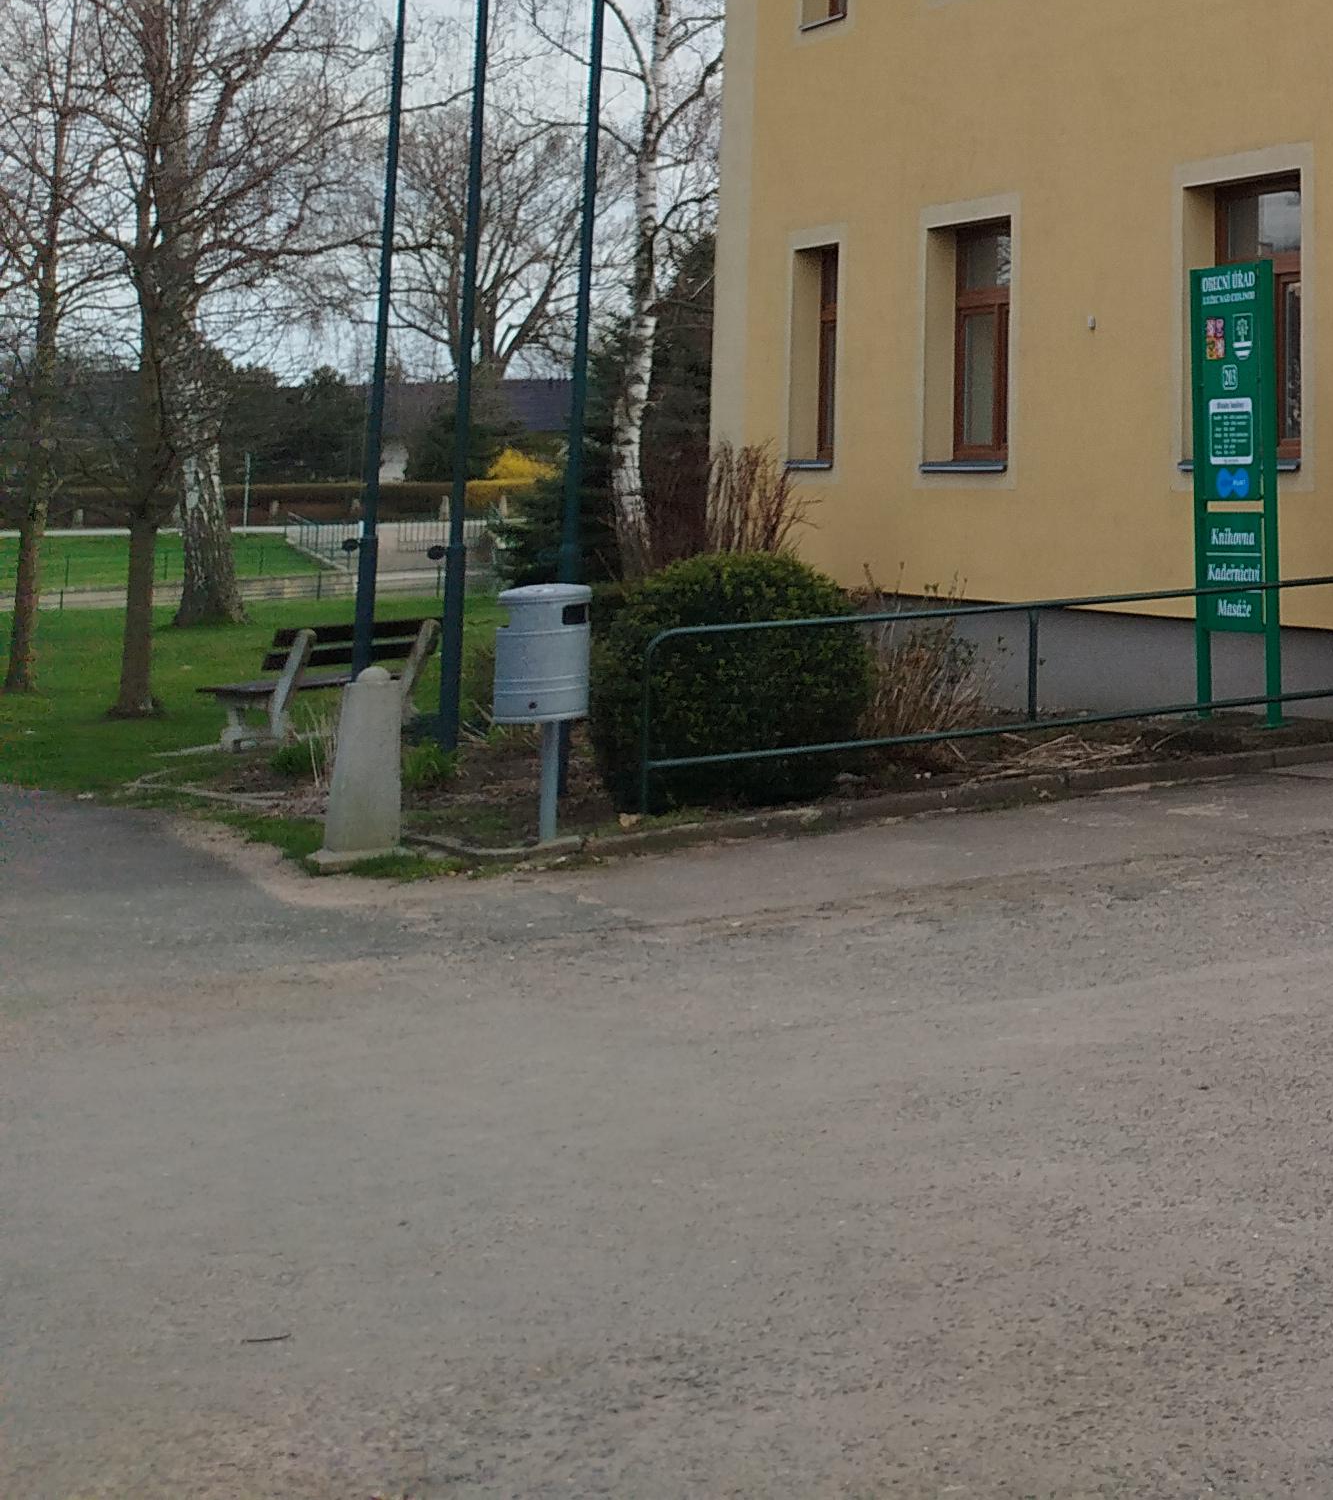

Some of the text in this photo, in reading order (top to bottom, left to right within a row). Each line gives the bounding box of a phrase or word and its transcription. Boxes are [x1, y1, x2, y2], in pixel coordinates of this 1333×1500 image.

[1202, 269, 1256, 293] OBECNÍ ÚŘAD
[1211, 527, 1255, 546] Knihovna
[1207, 563, 1260, 582] Kadeřnictví
[1217, 598, 1252, 618] Masáže
